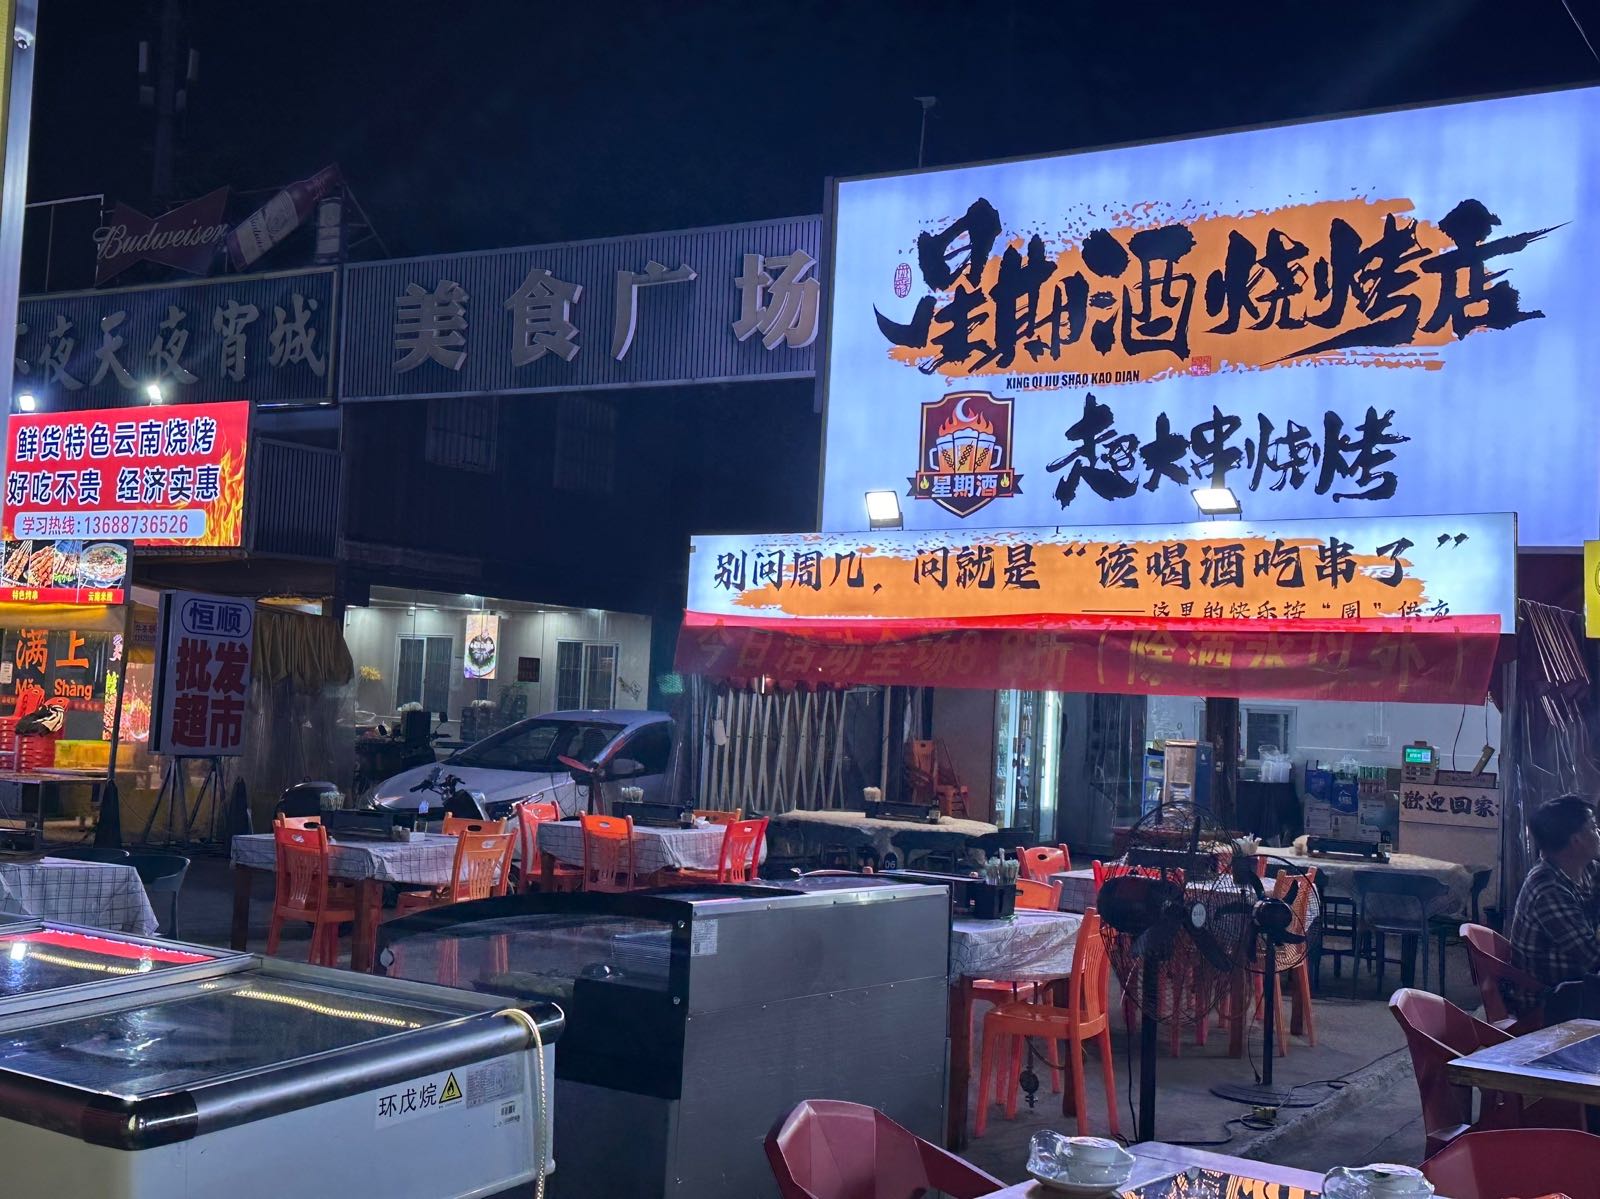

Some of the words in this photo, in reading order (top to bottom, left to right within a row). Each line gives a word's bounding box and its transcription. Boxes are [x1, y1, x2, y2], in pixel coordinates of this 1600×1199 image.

[92, 219, 227, 259] Budweiser
[873, 198, 1573, 373] 星期酒烧烤店
[392, 249, 821, 374] 美食广场
[14, 293, 326, 392] 夜天夜宵城
[1006, 377, 1030, 389] XING
[1032, 376, 1042, 389] QI
[1045, 375, 1059, 387] JIU
[1061, 373, 1089, 387] SHAO
[1091, 371, 1112, 384] KAO
[1115, 370, 1140, 383] DIAN
[16, 416, 217, 461] 鲜货特色云南烧烤
[1045, 392, 1412, 511] 超大串烧烤
[7, 468, 102, 506] 好吃不贵
[116, 463, 220, 502] 经济实惠
[931, 474, 998, 498] 星期酒
[22, 514, 189, 536] 学习热线:13688736526
[189, 602, 243, 634] 恒顺
[15, 628, 89, 674] 满上
[176, 638, 249, 694] 批发
[54, 678, 93, 700] Shàng
[171, 694, 245, 749] 超市
[1402, 790, 1499, 817] 歡迎回家
[378, 1083, 437, 1117] 环戊烷
